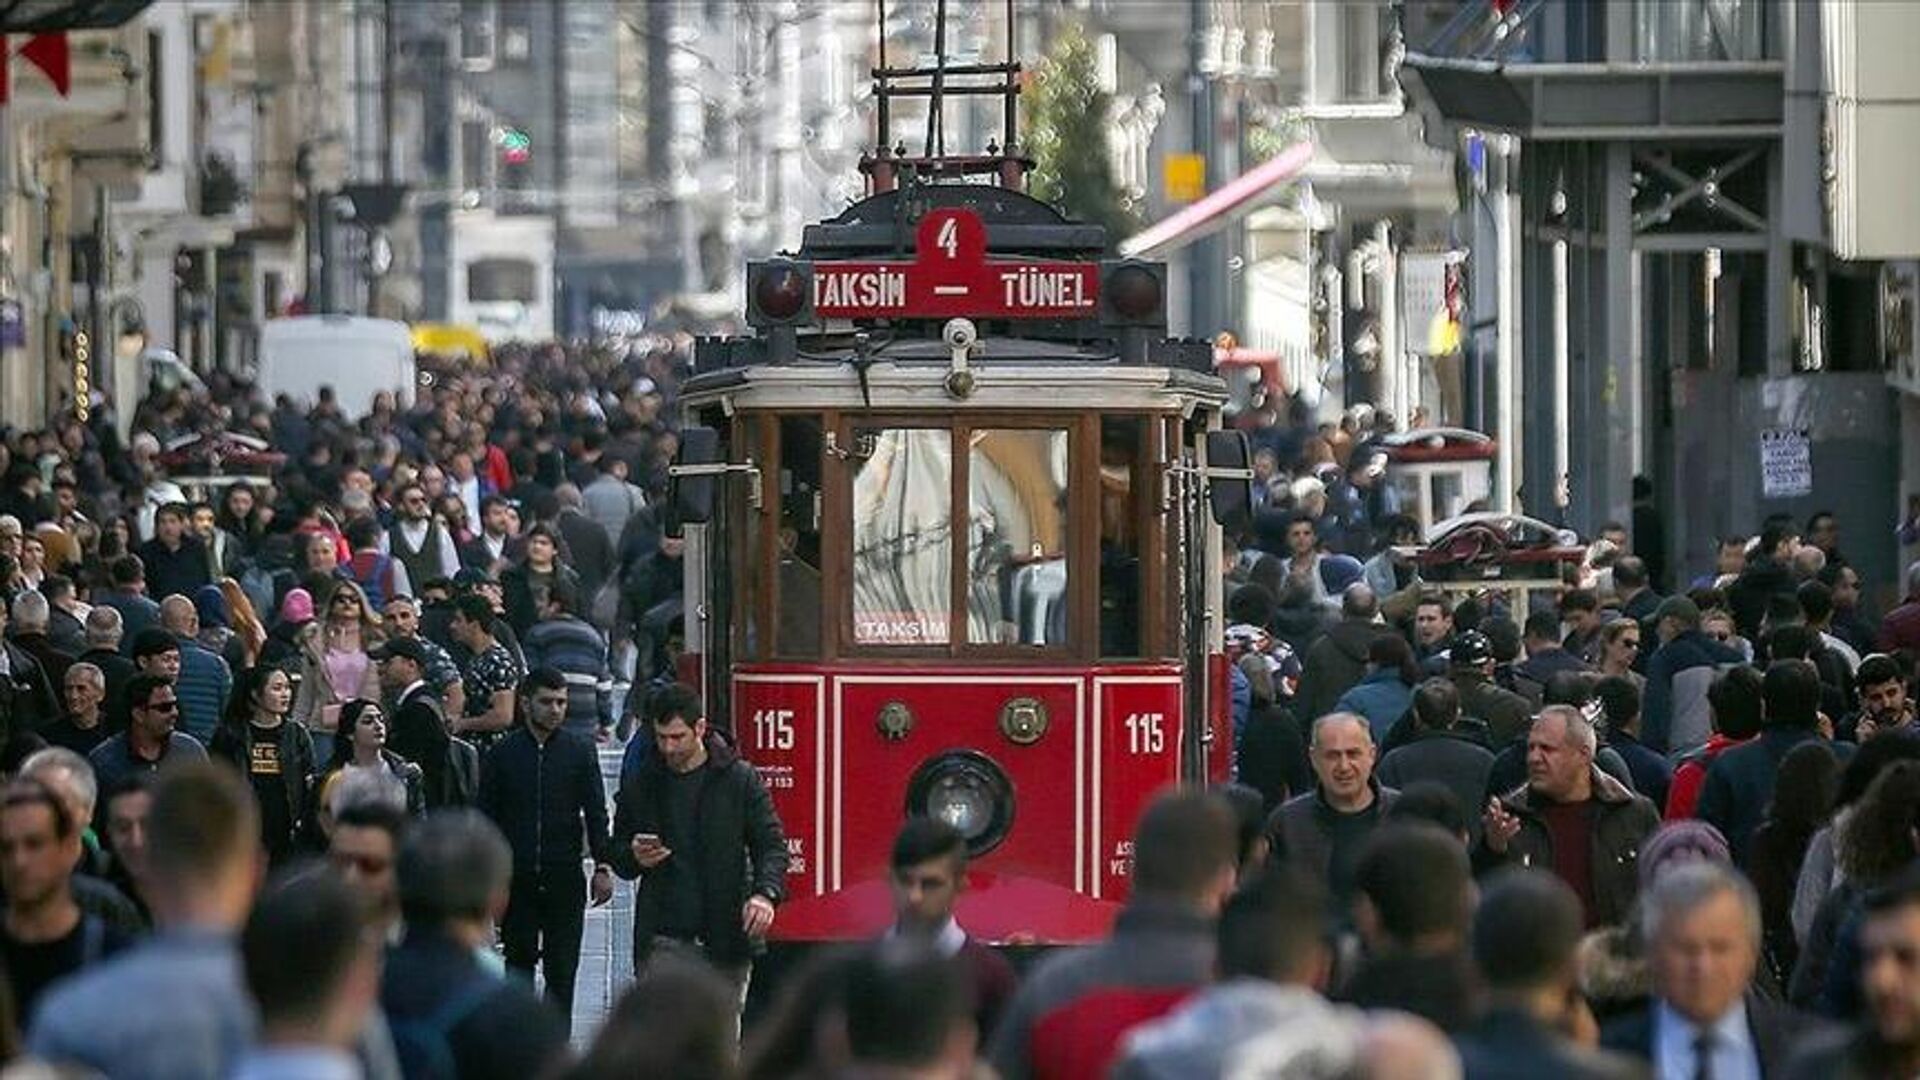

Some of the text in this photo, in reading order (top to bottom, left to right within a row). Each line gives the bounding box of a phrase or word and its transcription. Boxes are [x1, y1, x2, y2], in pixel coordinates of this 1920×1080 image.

[937, 217, 959, 259] 4
[813, 267, 906, 307] TAKSİM
[1000, 267, 1095, 307] TÜNEL
[753, 709, 795, 750] 115
[1125, 713, 1164, 754] 115
[1110, 858, 1127, 875] VE
